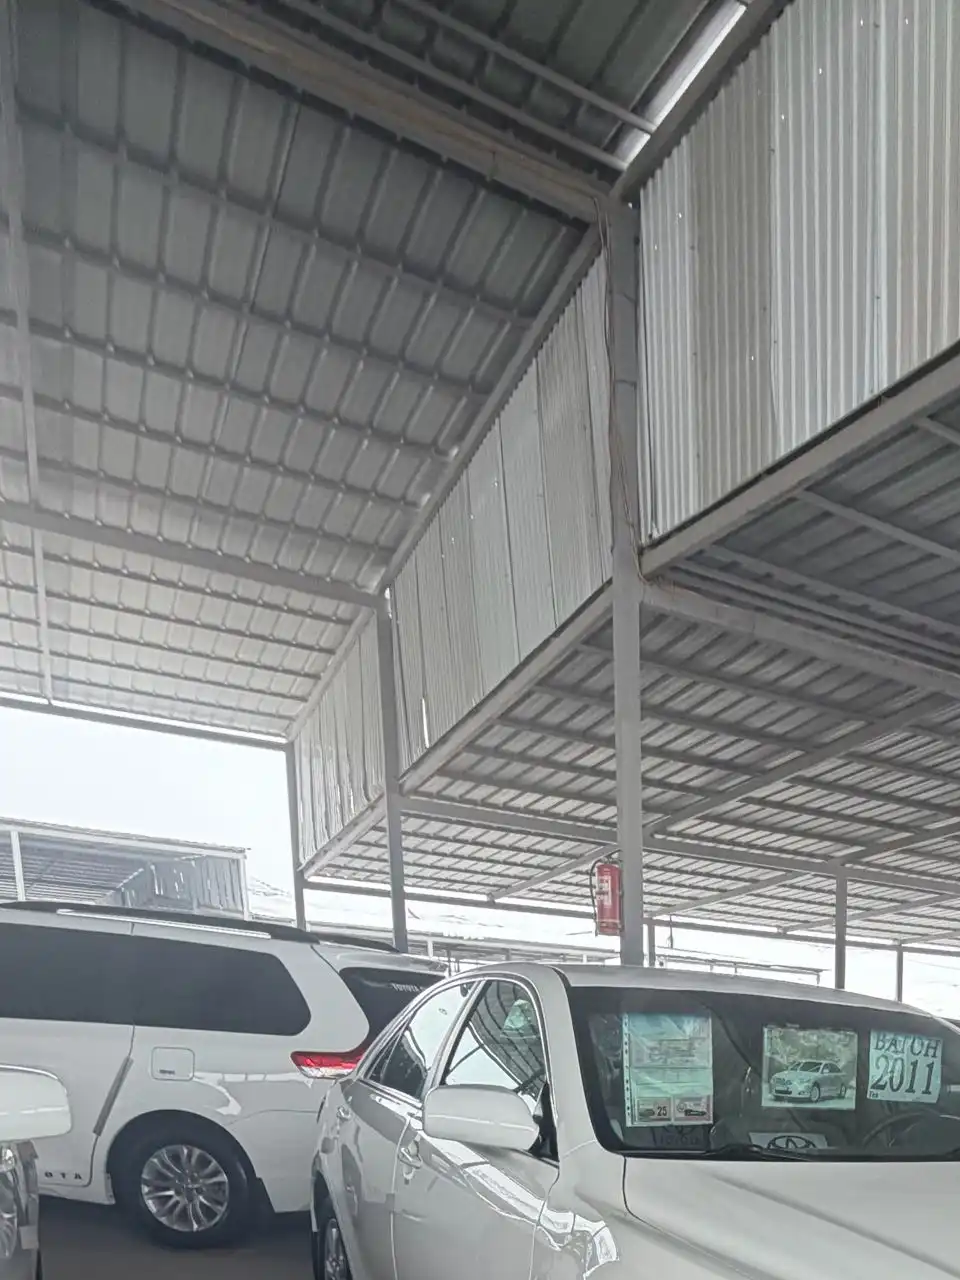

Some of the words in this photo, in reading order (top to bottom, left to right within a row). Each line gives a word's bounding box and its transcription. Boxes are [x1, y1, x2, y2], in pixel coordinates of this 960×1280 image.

[870, 1054, 935, 1095] 2011
[656, 1106, 668, 1117] 25
[44, 1171, 82, 1181] OTA
